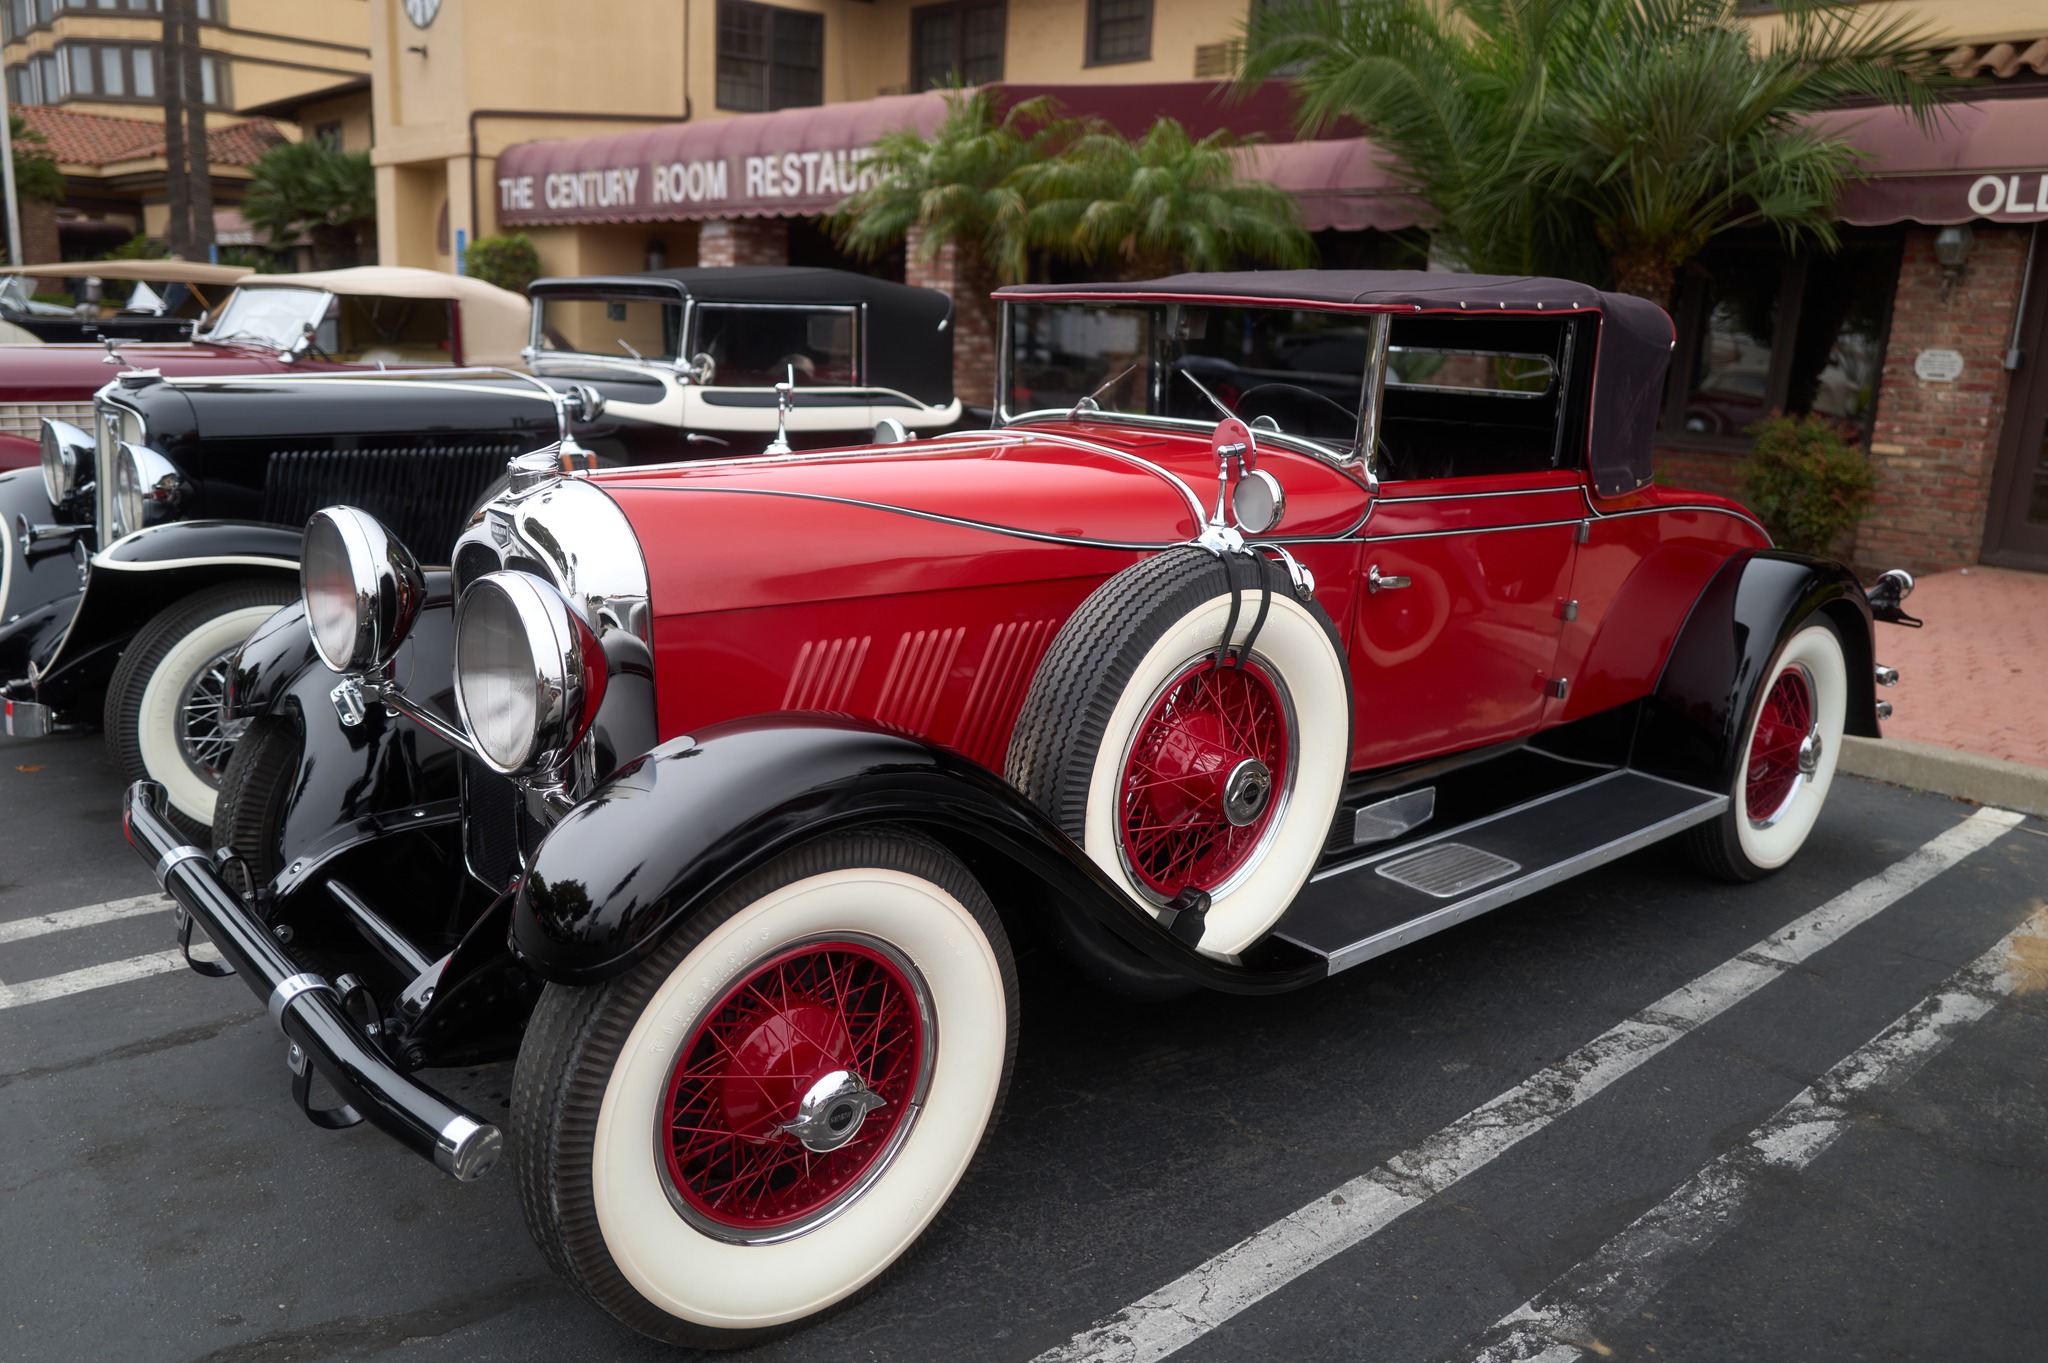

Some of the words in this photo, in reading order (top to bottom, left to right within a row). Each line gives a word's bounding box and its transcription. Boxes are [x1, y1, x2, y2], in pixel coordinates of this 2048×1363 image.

[498, 176, 534, 211] THE
[545, 168, 640, 209] CENTURY
[654, 160, 727, 204] ROOM
